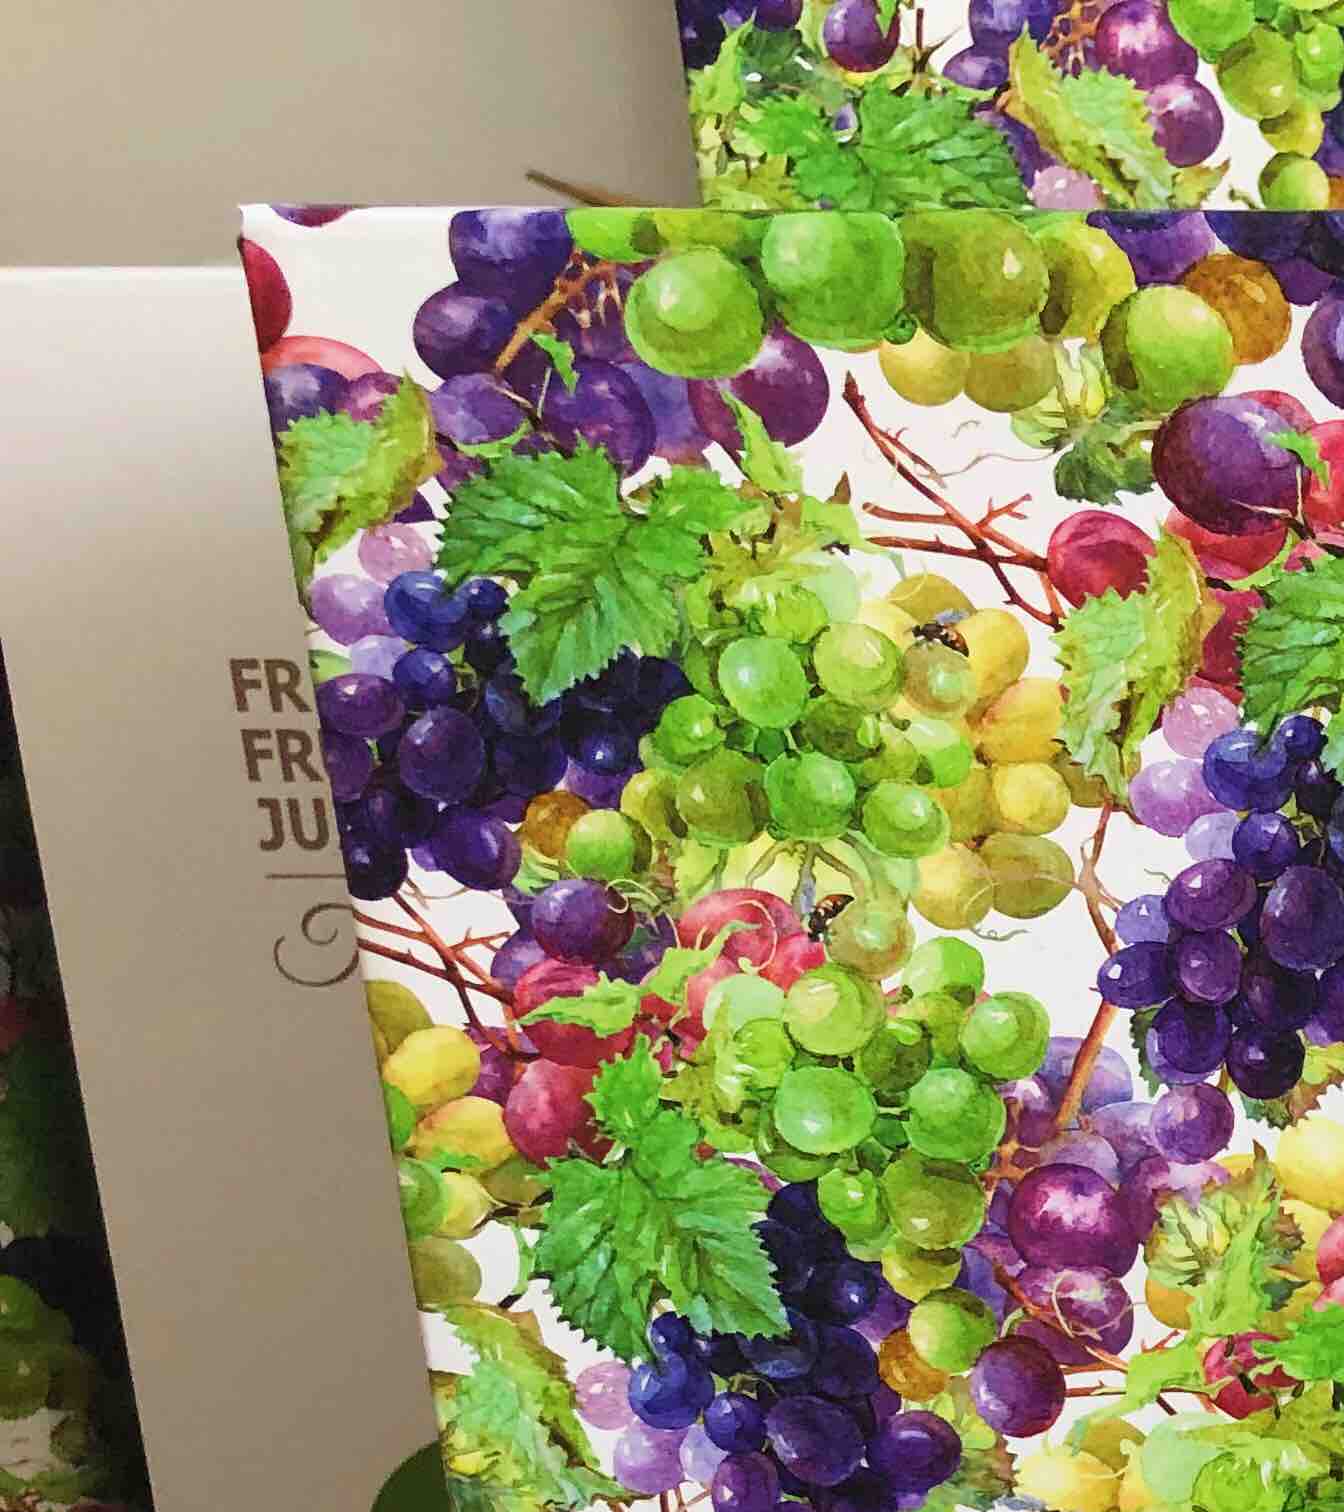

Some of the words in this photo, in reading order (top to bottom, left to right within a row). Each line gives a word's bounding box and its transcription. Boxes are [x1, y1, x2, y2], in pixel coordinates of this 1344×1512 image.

[229, 658, 313, 713] FR
[240, 728, 326, 782] FR
[256, 797, 331, 852] JU
